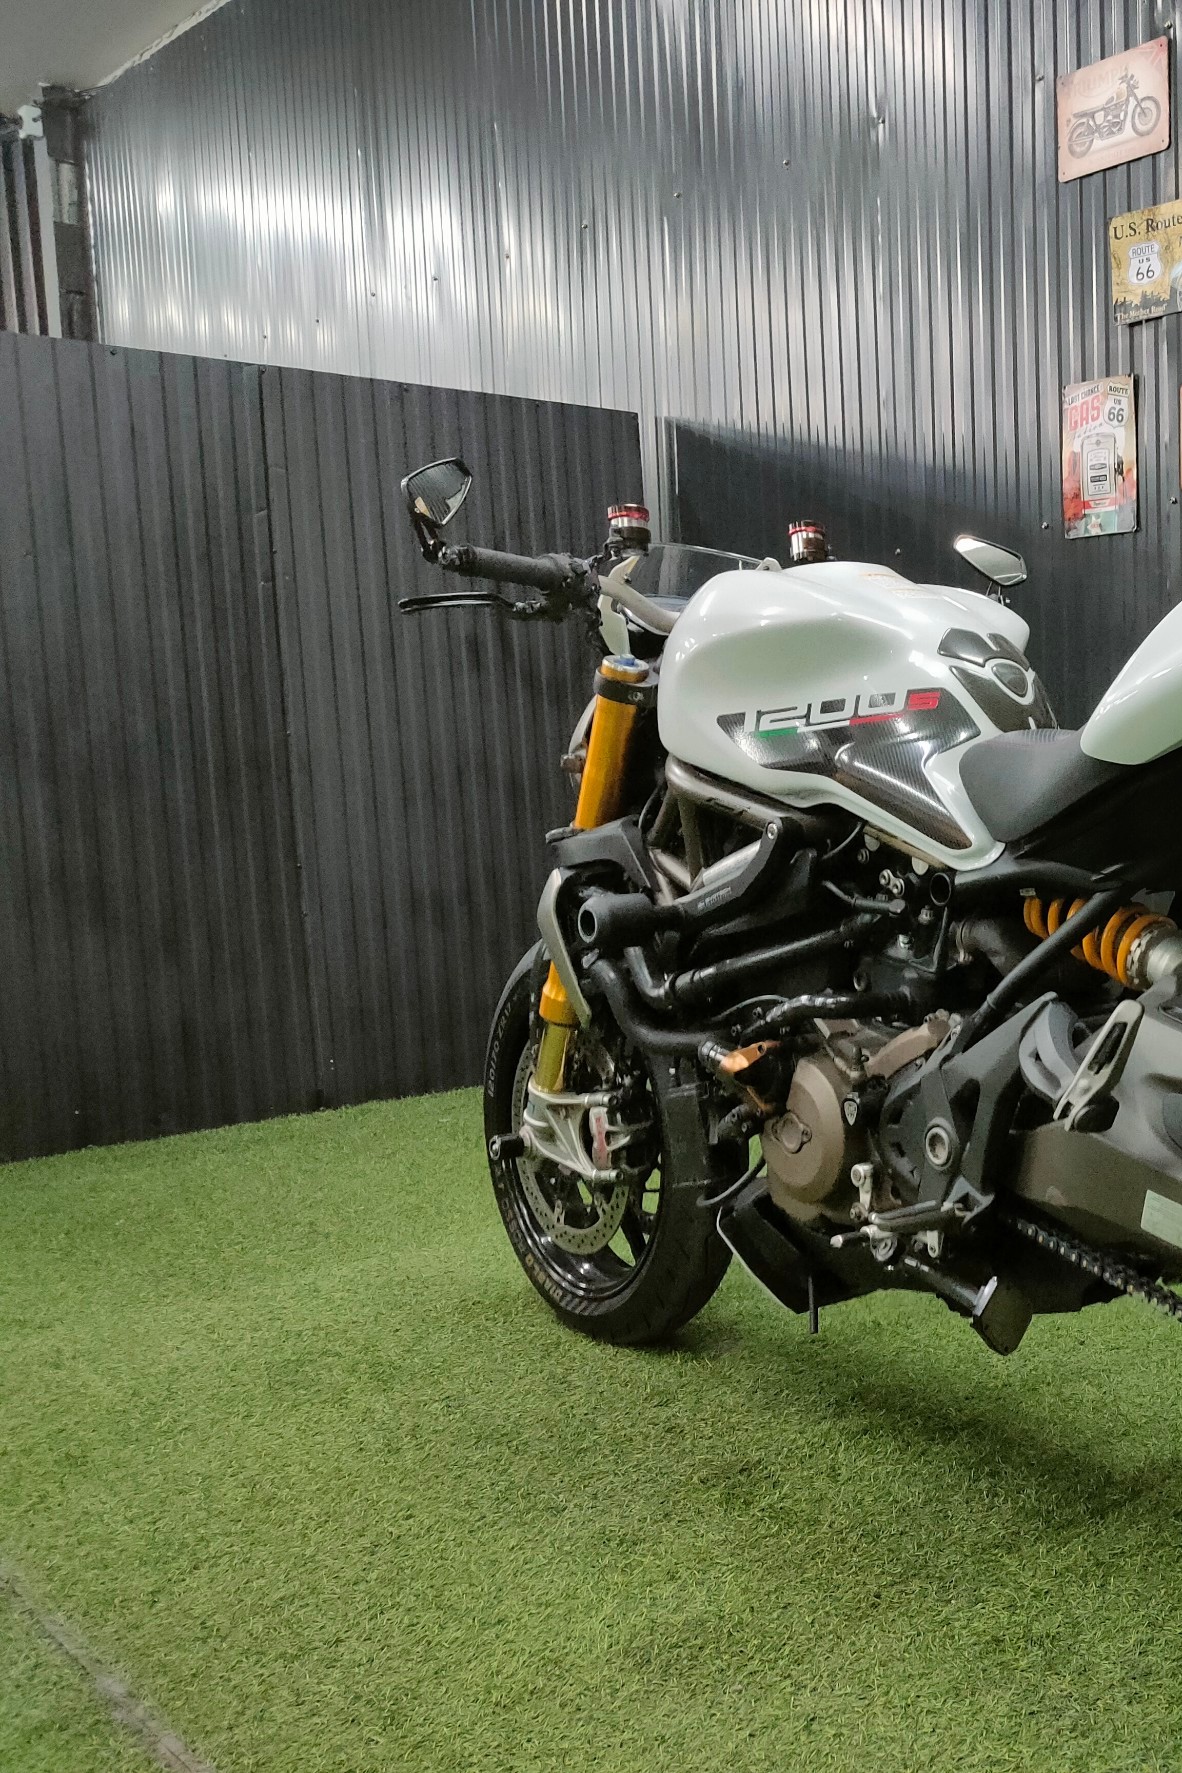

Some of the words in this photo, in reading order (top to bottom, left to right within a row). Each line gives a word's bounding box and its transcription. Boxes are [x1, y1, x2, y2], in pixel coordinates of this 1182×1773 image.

[1113, 221, 1140, 240] U.S.
[1145, 214, 1182, 234] Route
[1132, 244, 1155, 257] ROUTE
[1136, 264, 1155, 281] 66
[1108, 385, 1129, 395] ROUTE
[1107, 406, 1125, 423] 66
